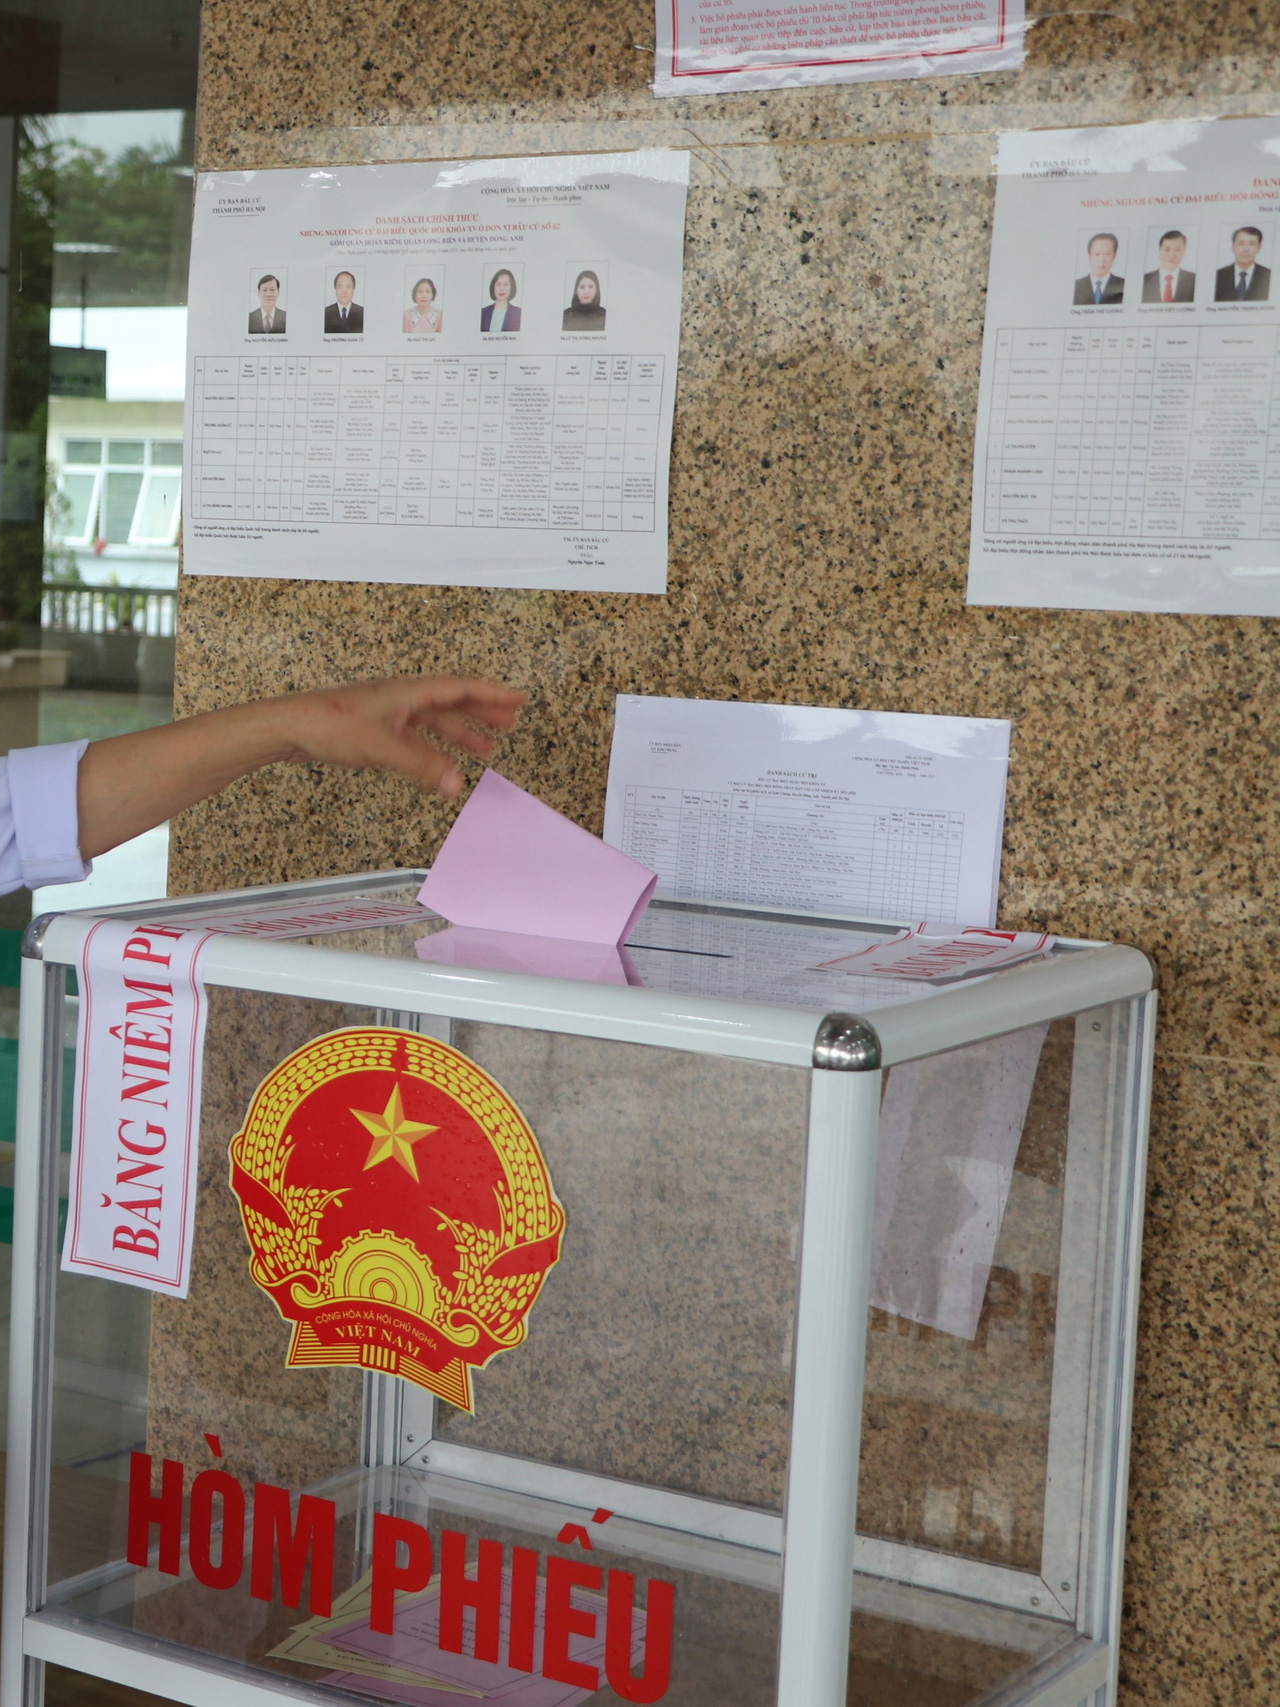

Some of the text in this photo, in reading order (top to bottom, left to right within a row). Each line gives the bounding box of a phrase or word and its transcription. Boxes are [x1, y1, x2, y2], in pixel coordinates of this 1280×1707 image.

[108, 975, 175, 1111] NIÊM
[100, 1119, 168, 1261] BĂNG
[315, 1308, 437, 1351] CỘNG HÒA XÃ HỘI CHỦ NGHĨA
[335, 1322, 421, 1358] VIỆT NAM
[126, 1433, 676, 1704] HÒM PHIẾU
